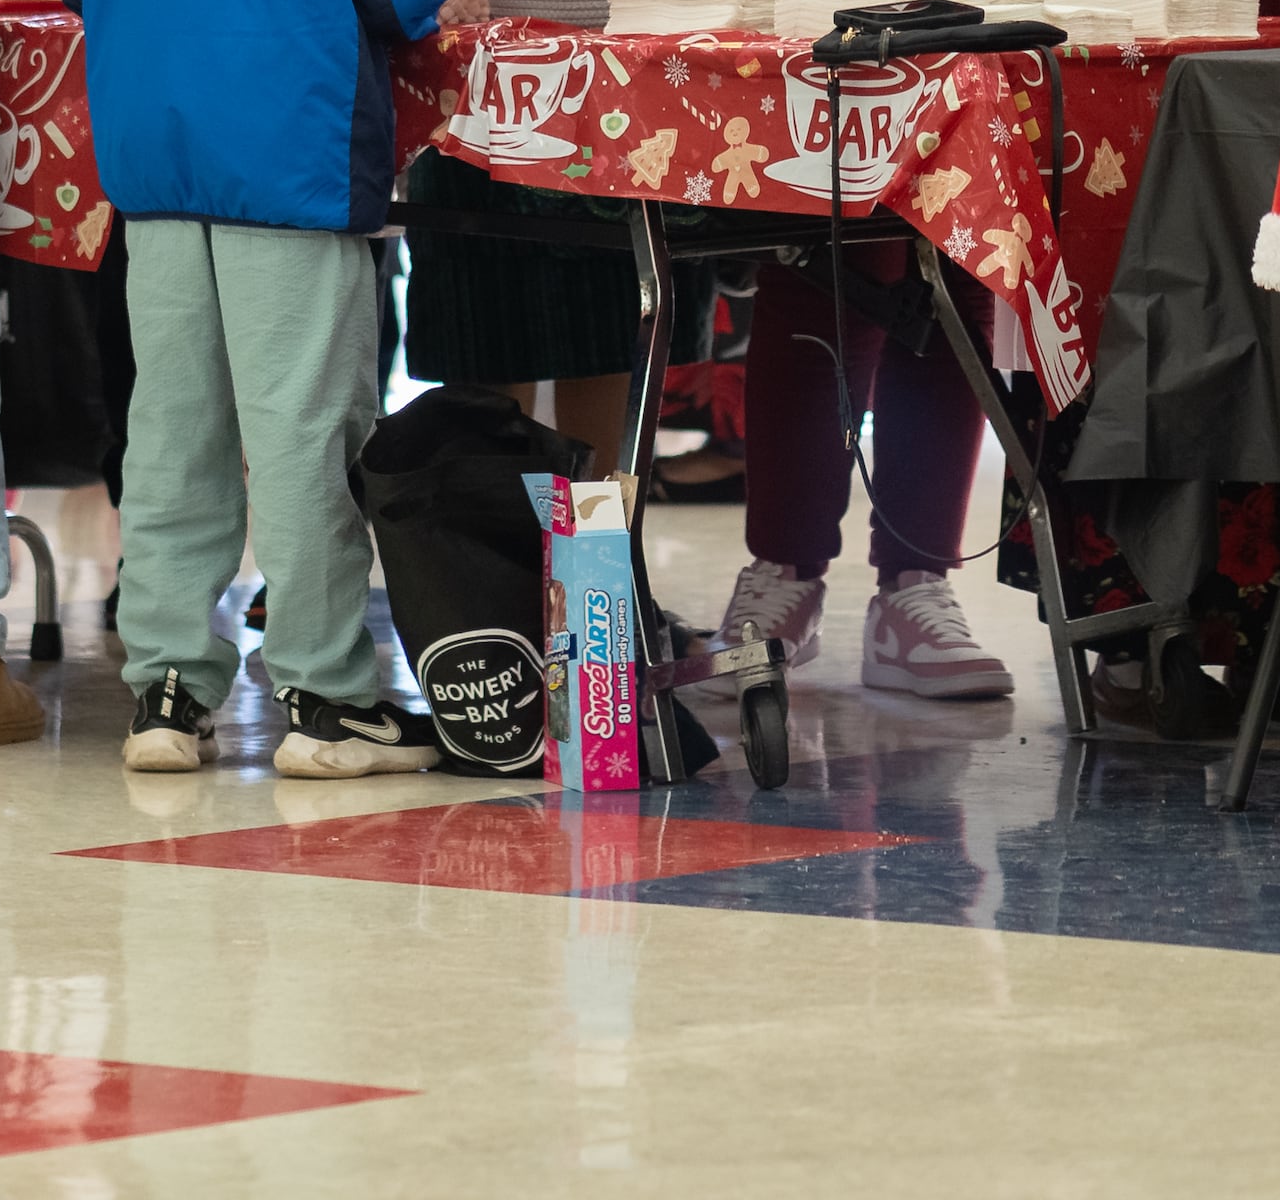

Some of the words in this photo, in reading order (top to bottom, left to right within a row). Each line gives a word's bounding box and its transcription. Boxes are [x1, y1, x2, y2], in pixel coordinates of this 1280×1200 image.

[480, 62, 541, 125] AR
[803, 98, 892, 161] BAR
[616, 599, 627, 636] Canes
[457, 659, 487, 673] THE
[617, 636, 630, 671] Candy
[432, 660, 523, 701] BOWERY
[617, 674, 630, 700] mini
[465, 699, 510, 723] BAY
[618, 703, 632, 724] 80
[474, 724, 522, 744] SHOPS
